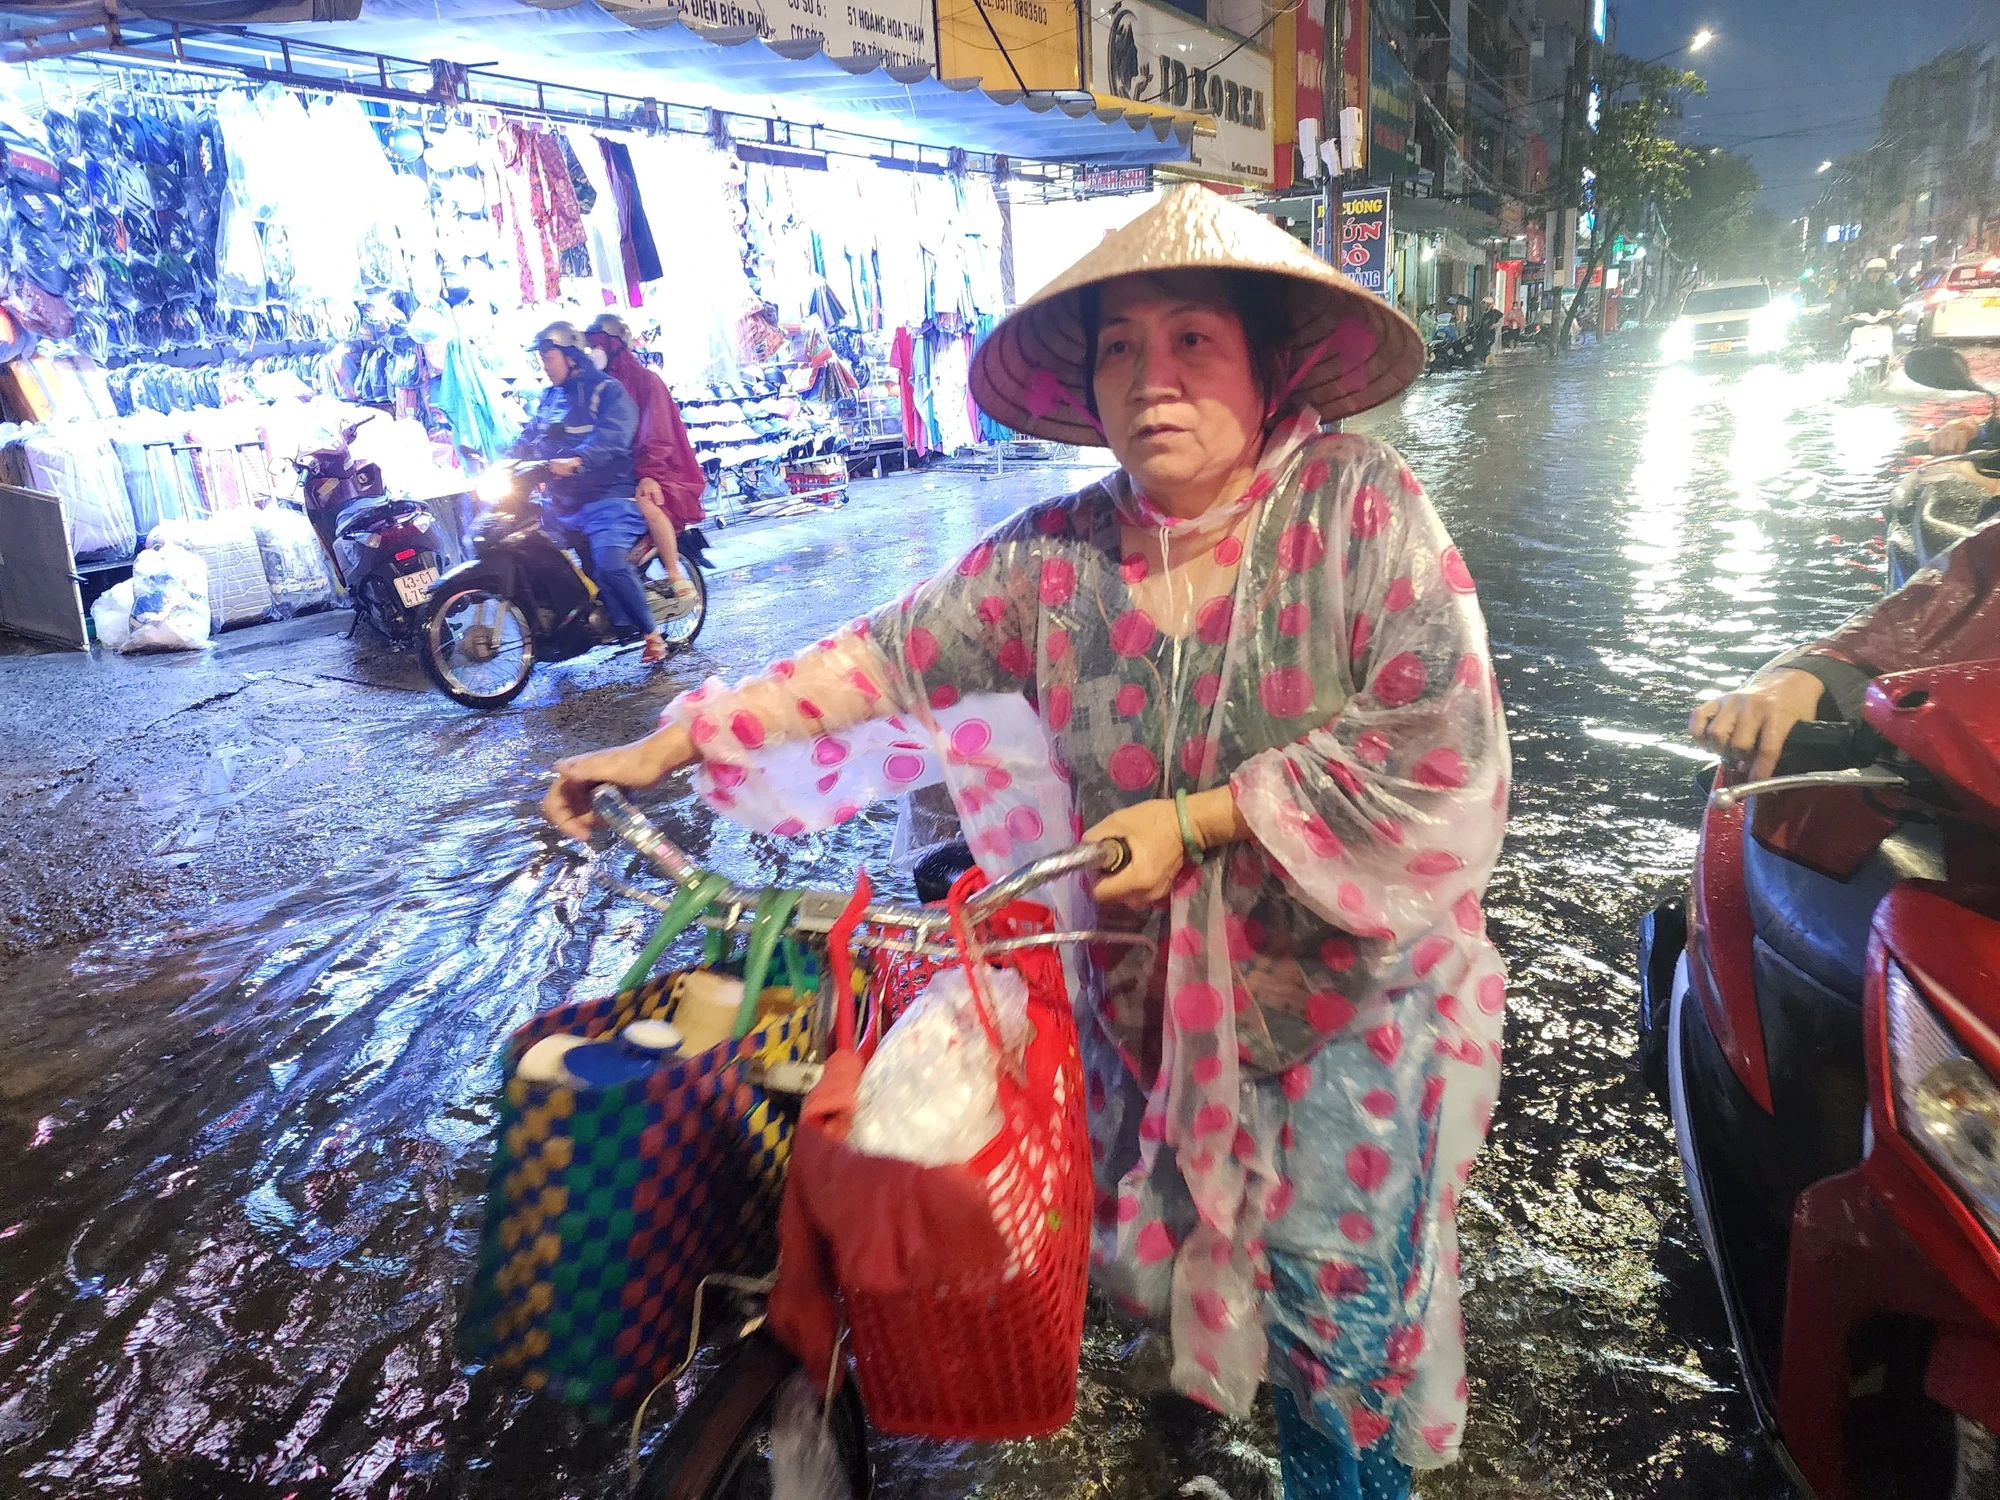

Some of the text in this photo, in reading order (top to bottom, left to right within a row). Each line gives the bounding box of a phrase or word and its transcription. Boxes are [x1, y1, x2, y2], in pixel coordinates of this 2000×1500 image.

[719, 1, 745, 27] BIÊN
[847, 5, 925, 46] 51 HOÀNG HOA THÁM
[902, 47, 927, 67] THẮ
[403, 571, 433, 589] 43-C1
